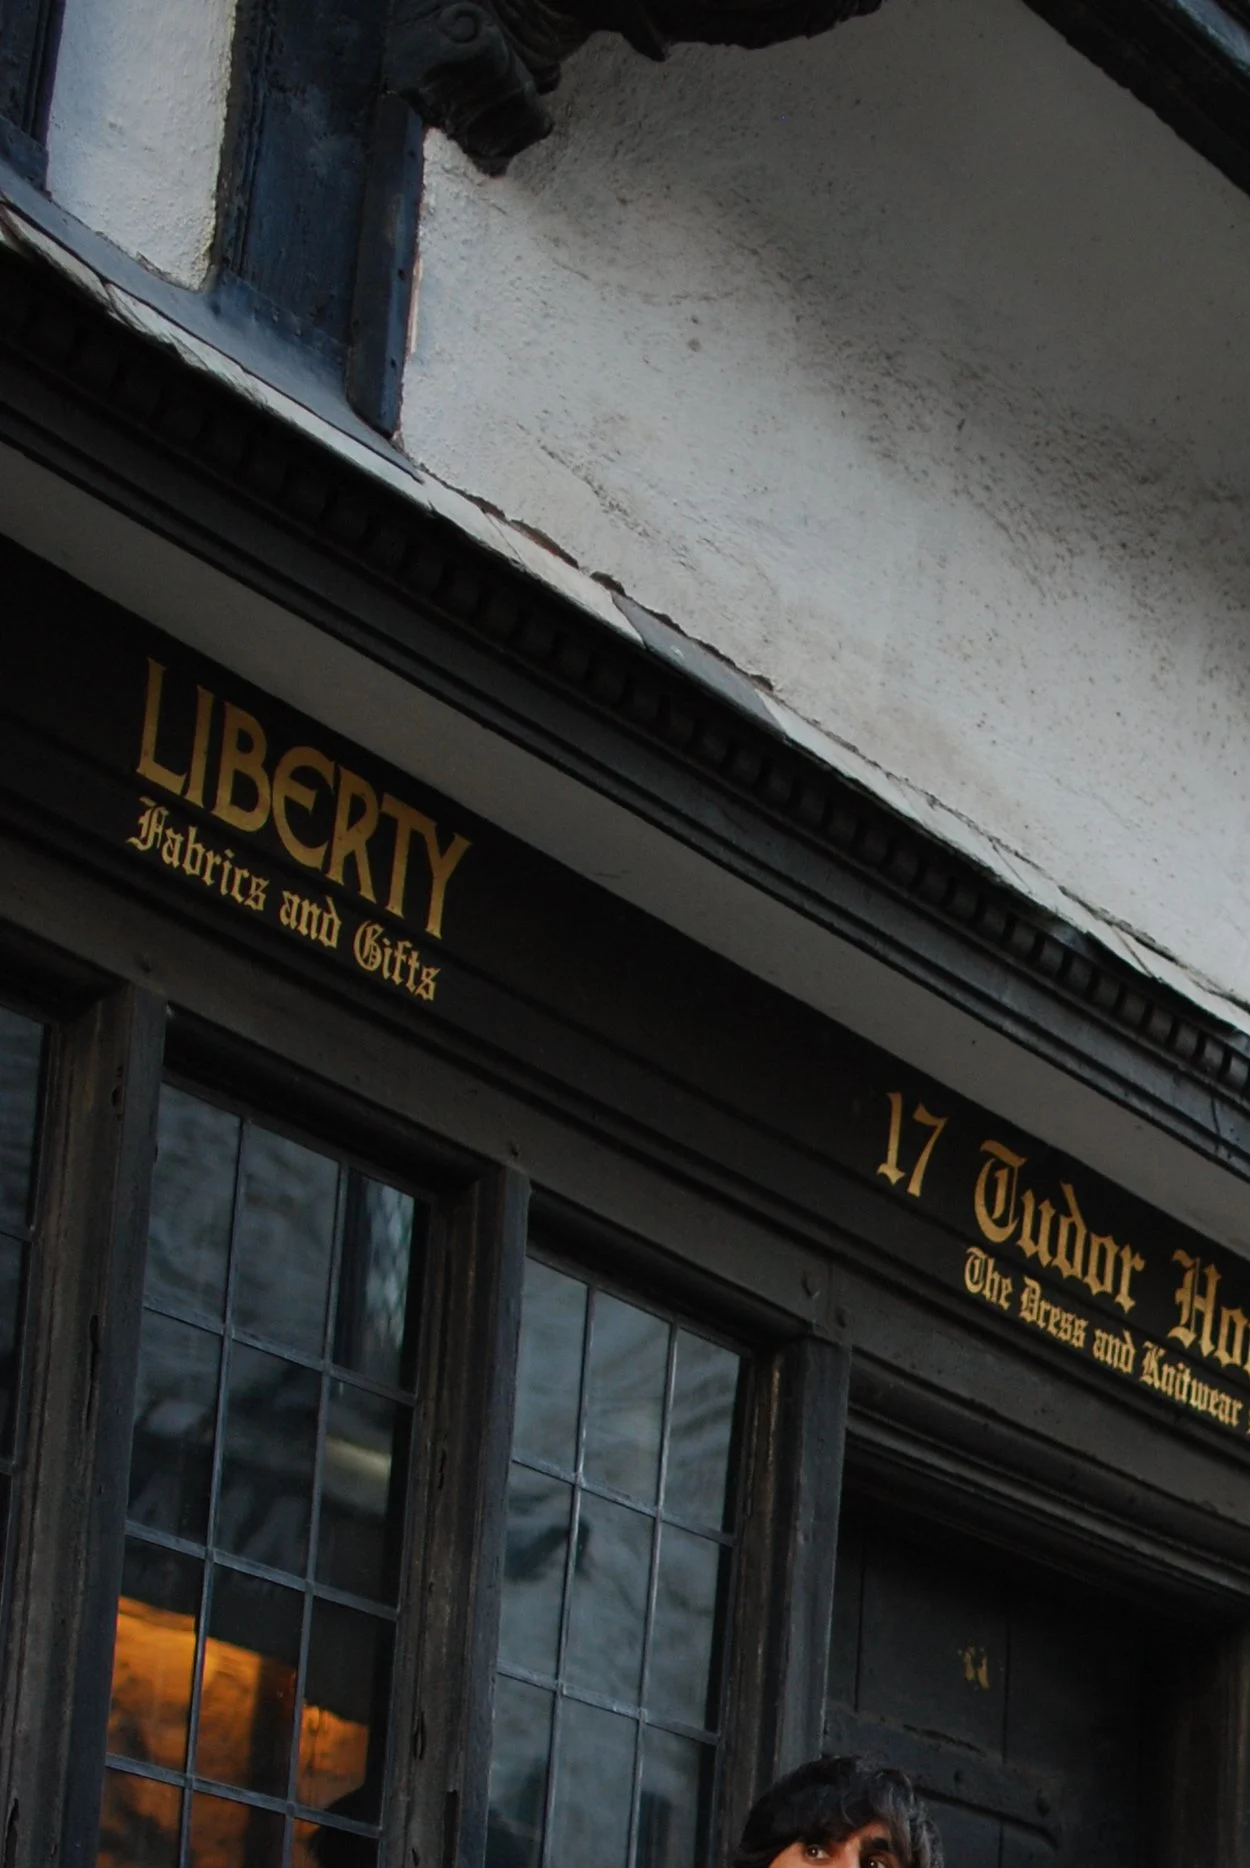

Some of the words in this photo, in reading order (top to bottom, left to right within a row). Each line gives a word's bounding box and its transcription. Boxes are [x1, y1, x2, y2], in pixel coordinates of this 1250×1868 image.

[126, 796, 270, 911] Fabrics
[280, 887, 343, 949] and
[353, 919, 441, 1001] Gifts
[136, 656, 473, 940] LIBERTY
[876, 1090, 949, 1198] 17
[973, 1138, 1147, 1314] Tudor
[964, 1246, 1013, 1311] The
[1019, 1274, 1089, 1349] Dress
[1093, 1326, 1136, 1375] and
[1137, 1339, 1243, 1429] Knitwear
